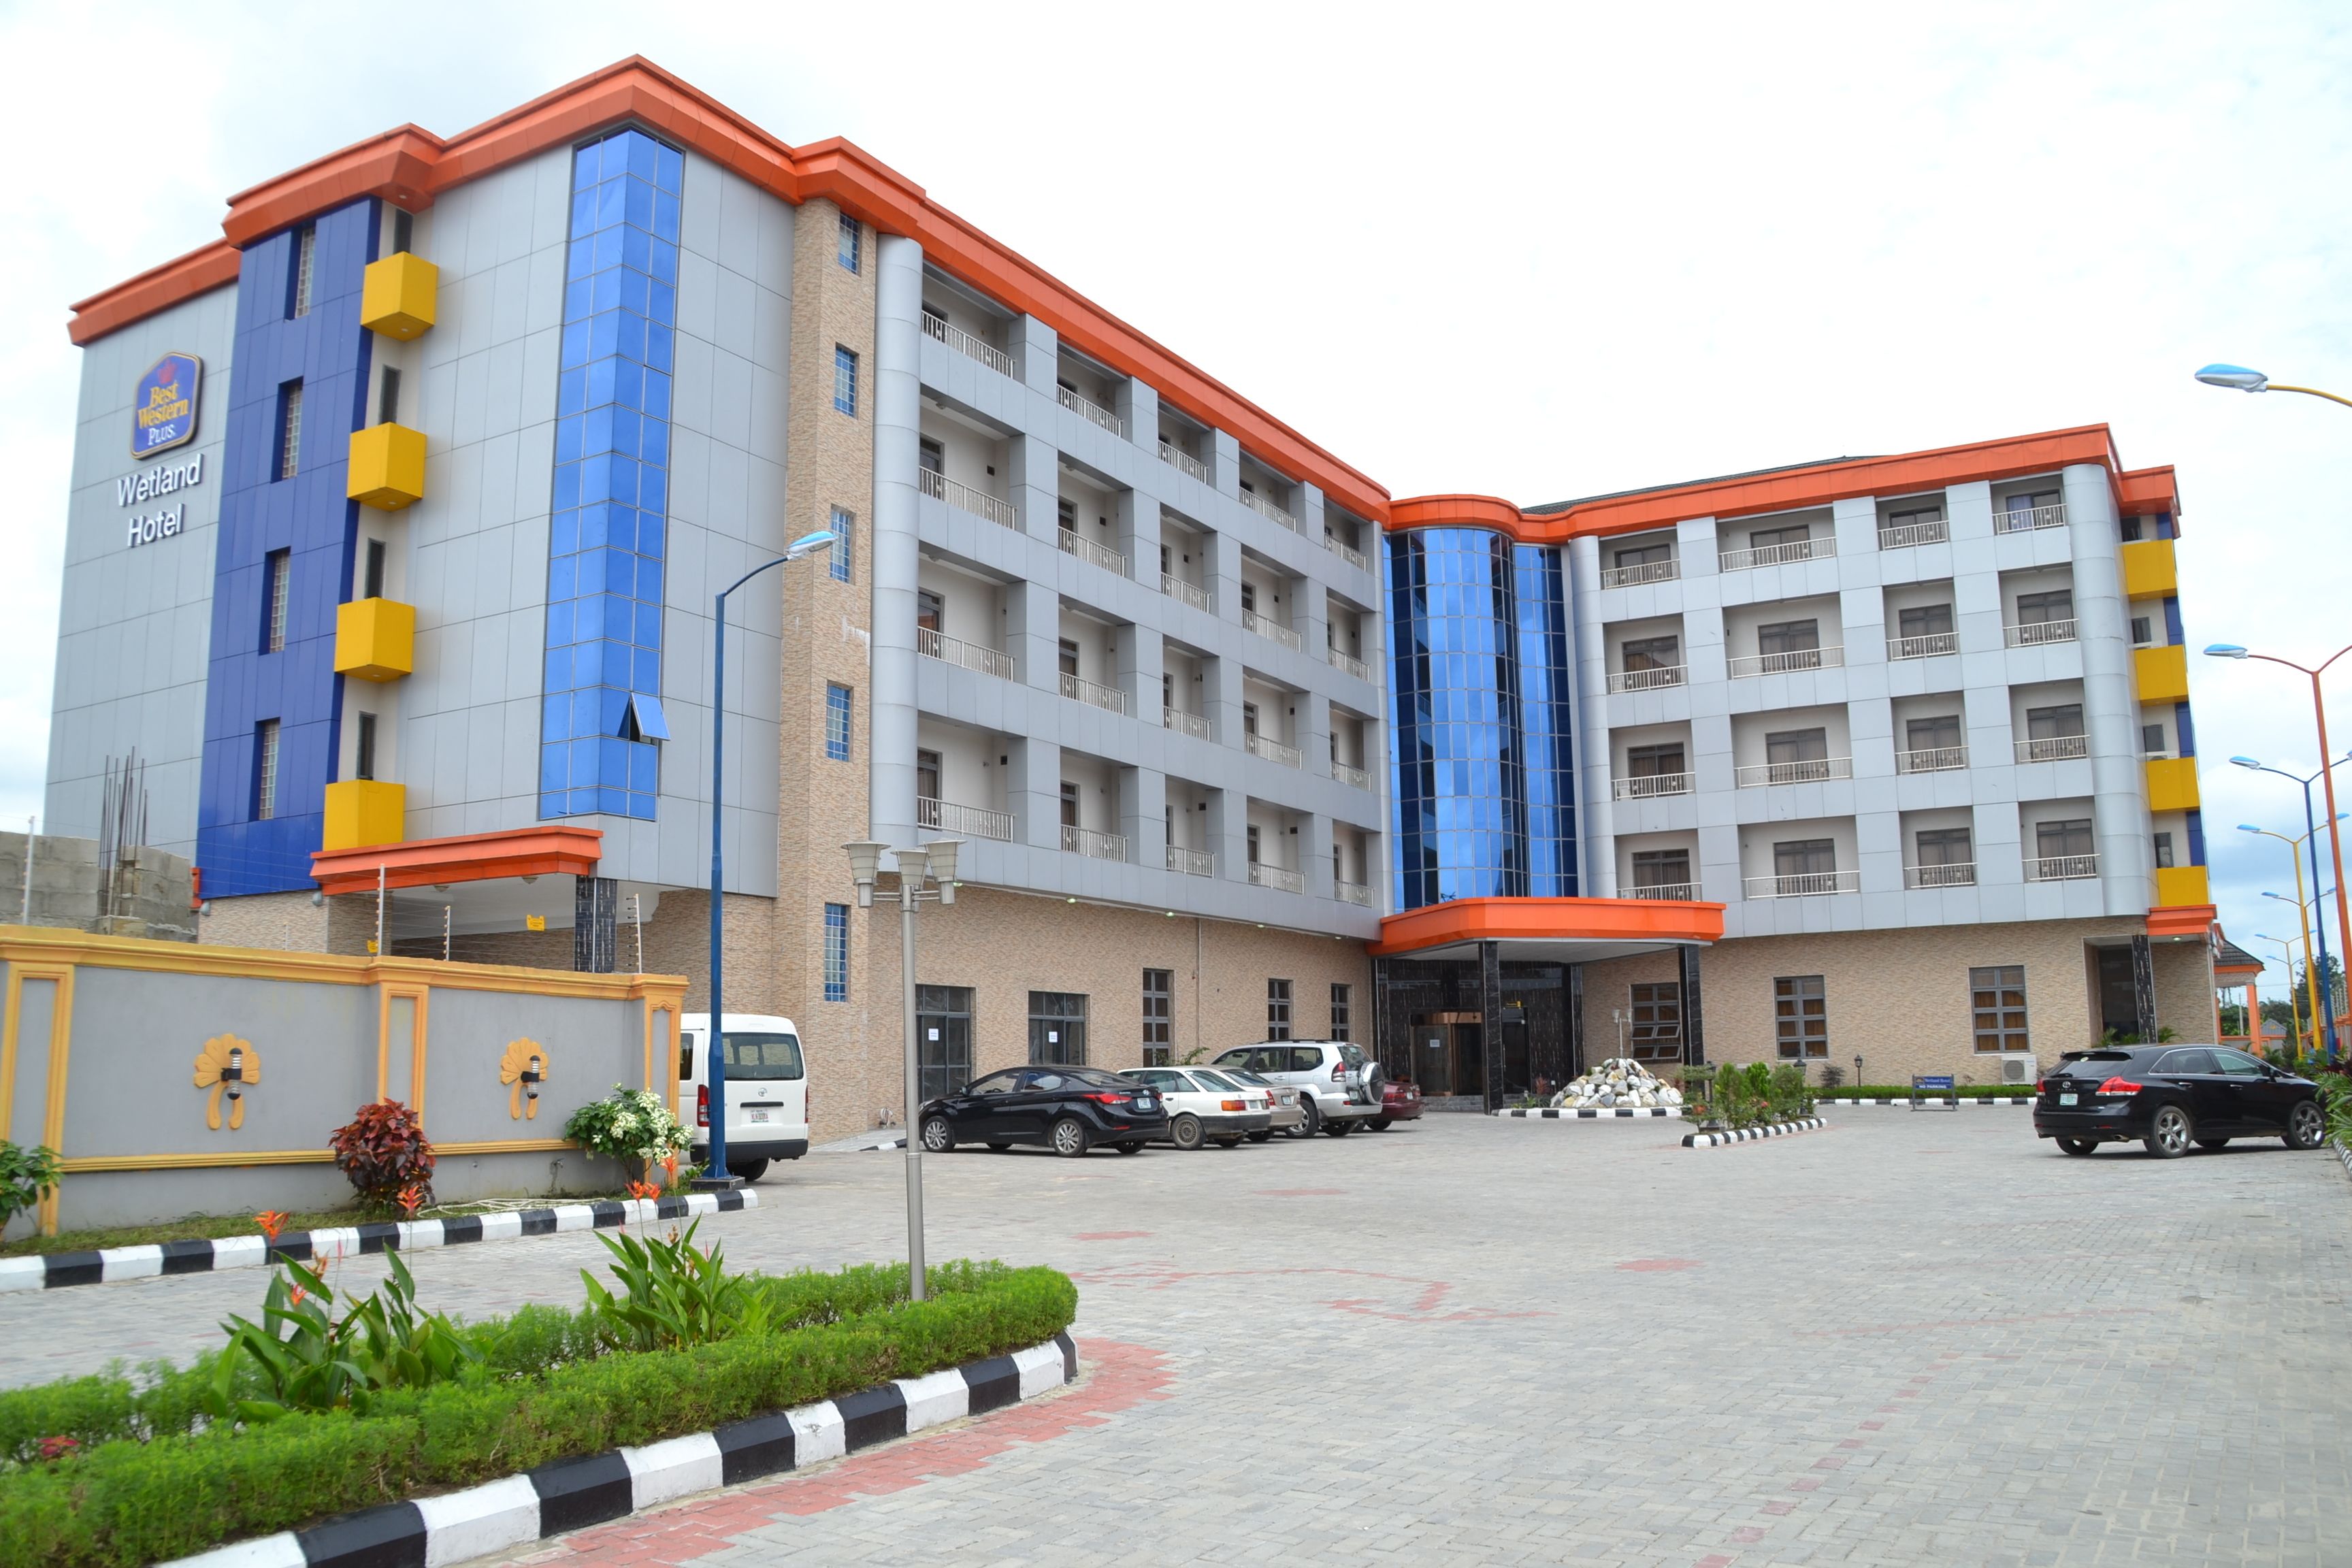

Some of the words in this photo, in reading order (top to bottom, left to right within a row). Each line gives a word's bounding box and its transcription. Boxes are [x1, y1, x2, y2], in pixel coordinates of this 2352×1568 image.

[150, 380, 179, 408] Best
[138, 399, 189, 429] Western
[117, 453, 203, 507] Wetland
[127, 502, 184, 548] Hotel
